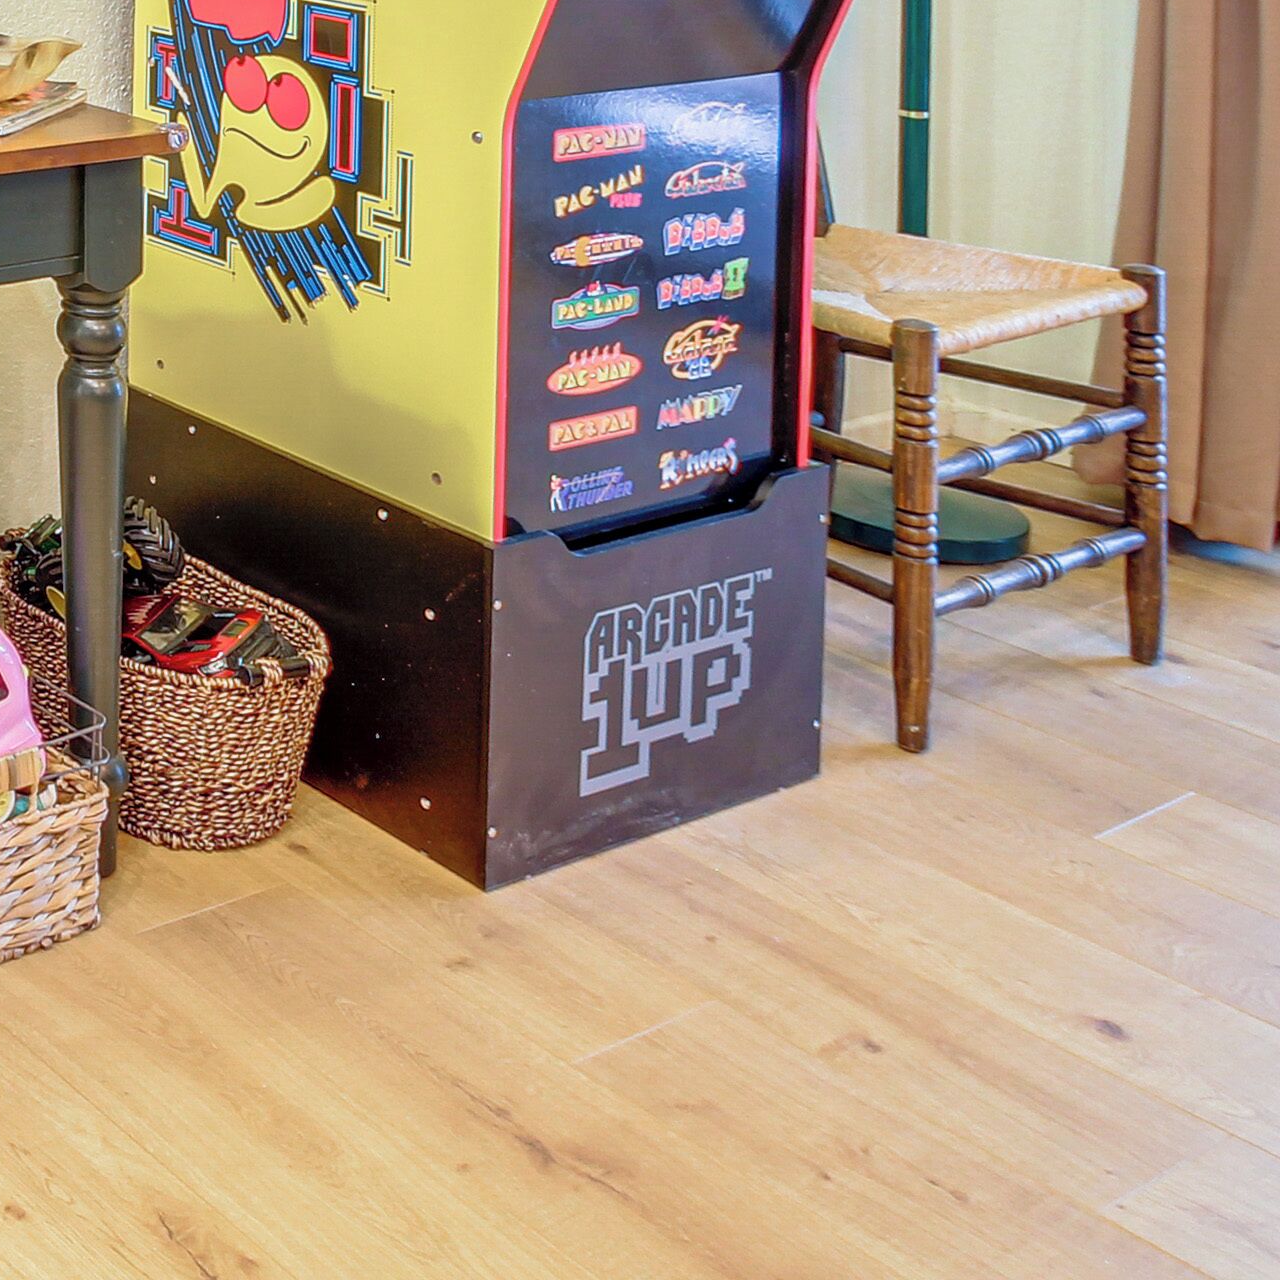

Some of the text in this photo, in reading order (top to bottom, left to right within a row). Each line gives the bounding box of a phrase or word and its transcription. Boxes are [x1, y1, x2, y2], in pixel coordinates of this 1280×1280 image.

[556, 125, 643, 156] PAC-MAN
[554, 164, 644, 218] PAC-MAN
[556, 294, 635, 321] PAC-LAND
[555, 360, 634, 392] PAC-MAN
[655, 383, 744, 430] MAPPY
[553, 422, 585, 446] PAC
[600, 410, 633, 435] PAL
[585, 572, 755, 676] ARCADE
[580, 642, 751, 798] 1UP
